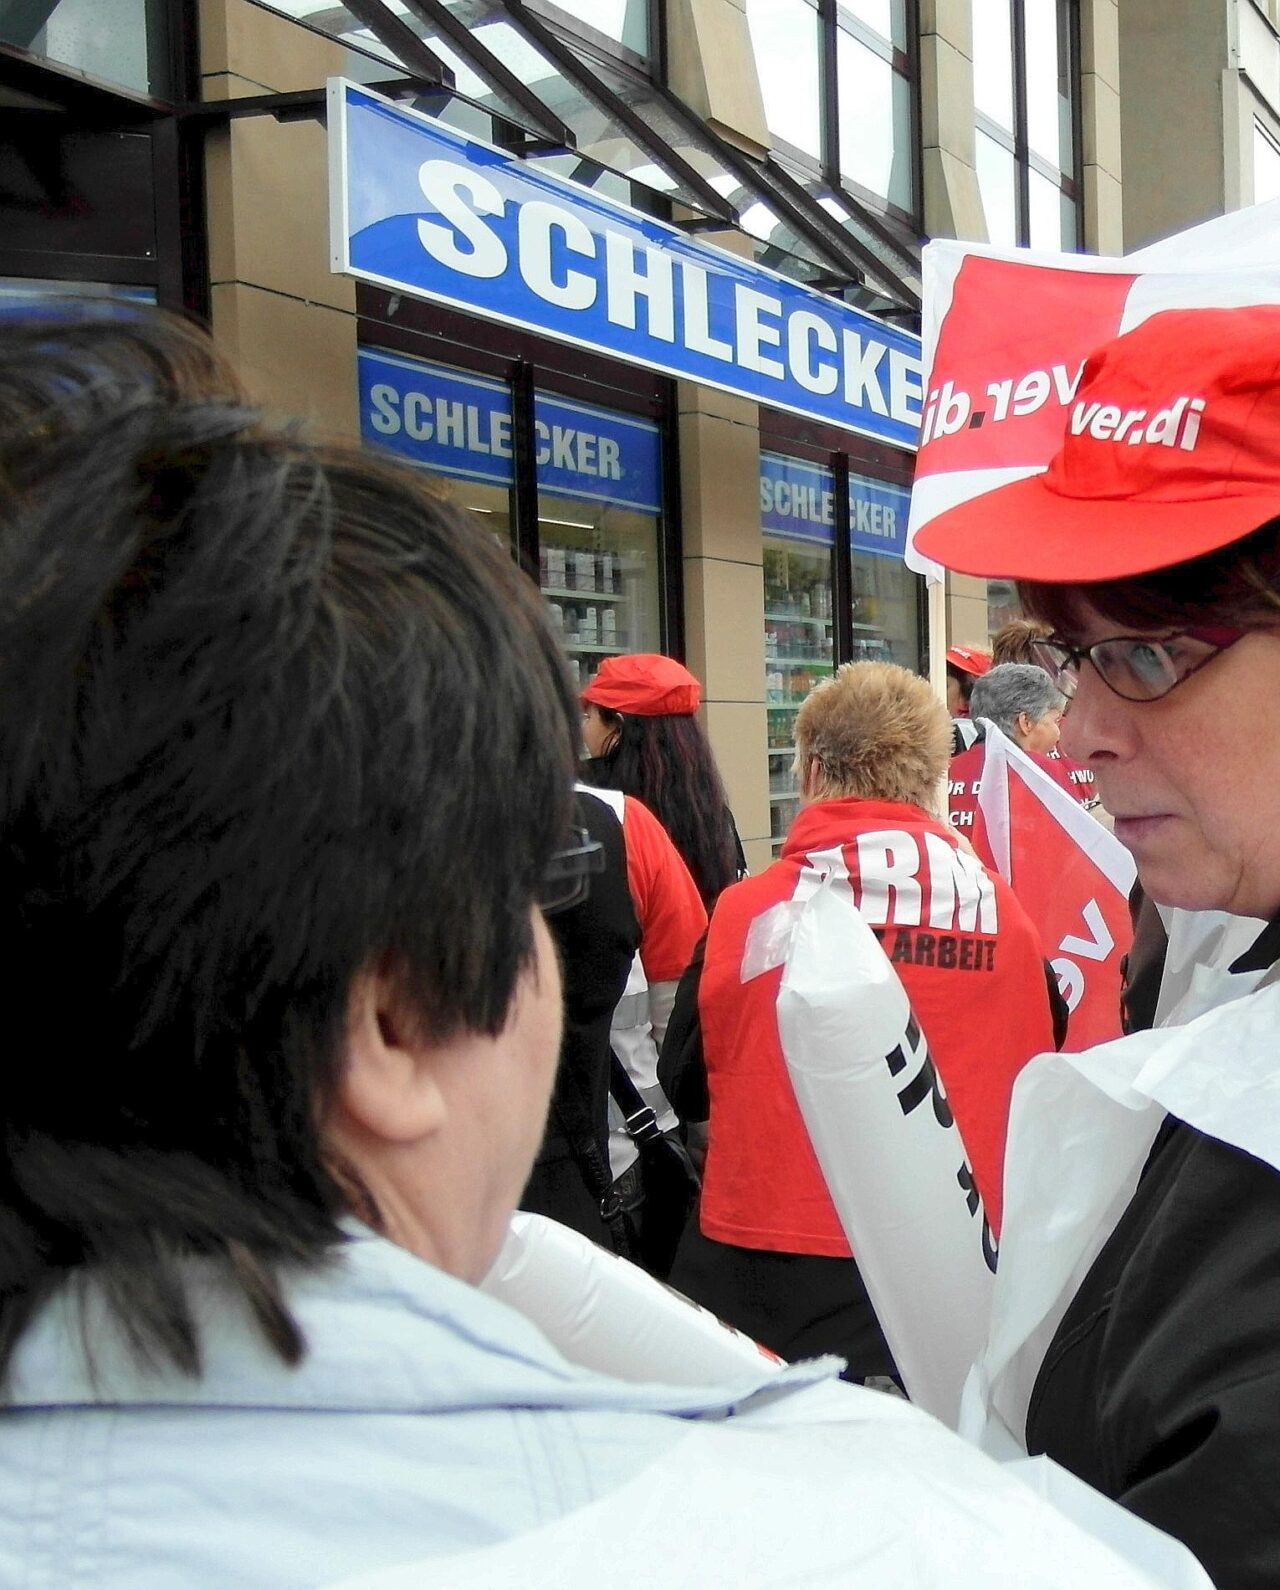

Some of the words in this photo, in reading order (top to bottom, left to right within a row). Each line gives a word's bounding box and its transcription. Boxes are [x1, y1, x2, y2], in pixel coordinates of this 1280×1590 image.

[416, 159, 922, 429] SCHLECKE
[370, 383, 621, 481] SCHLECKER
[1071, 396, 1207, 451] ver.di
[949, 810, 976, 826] CH
[891, 929, 998, 972] ARBEIT
